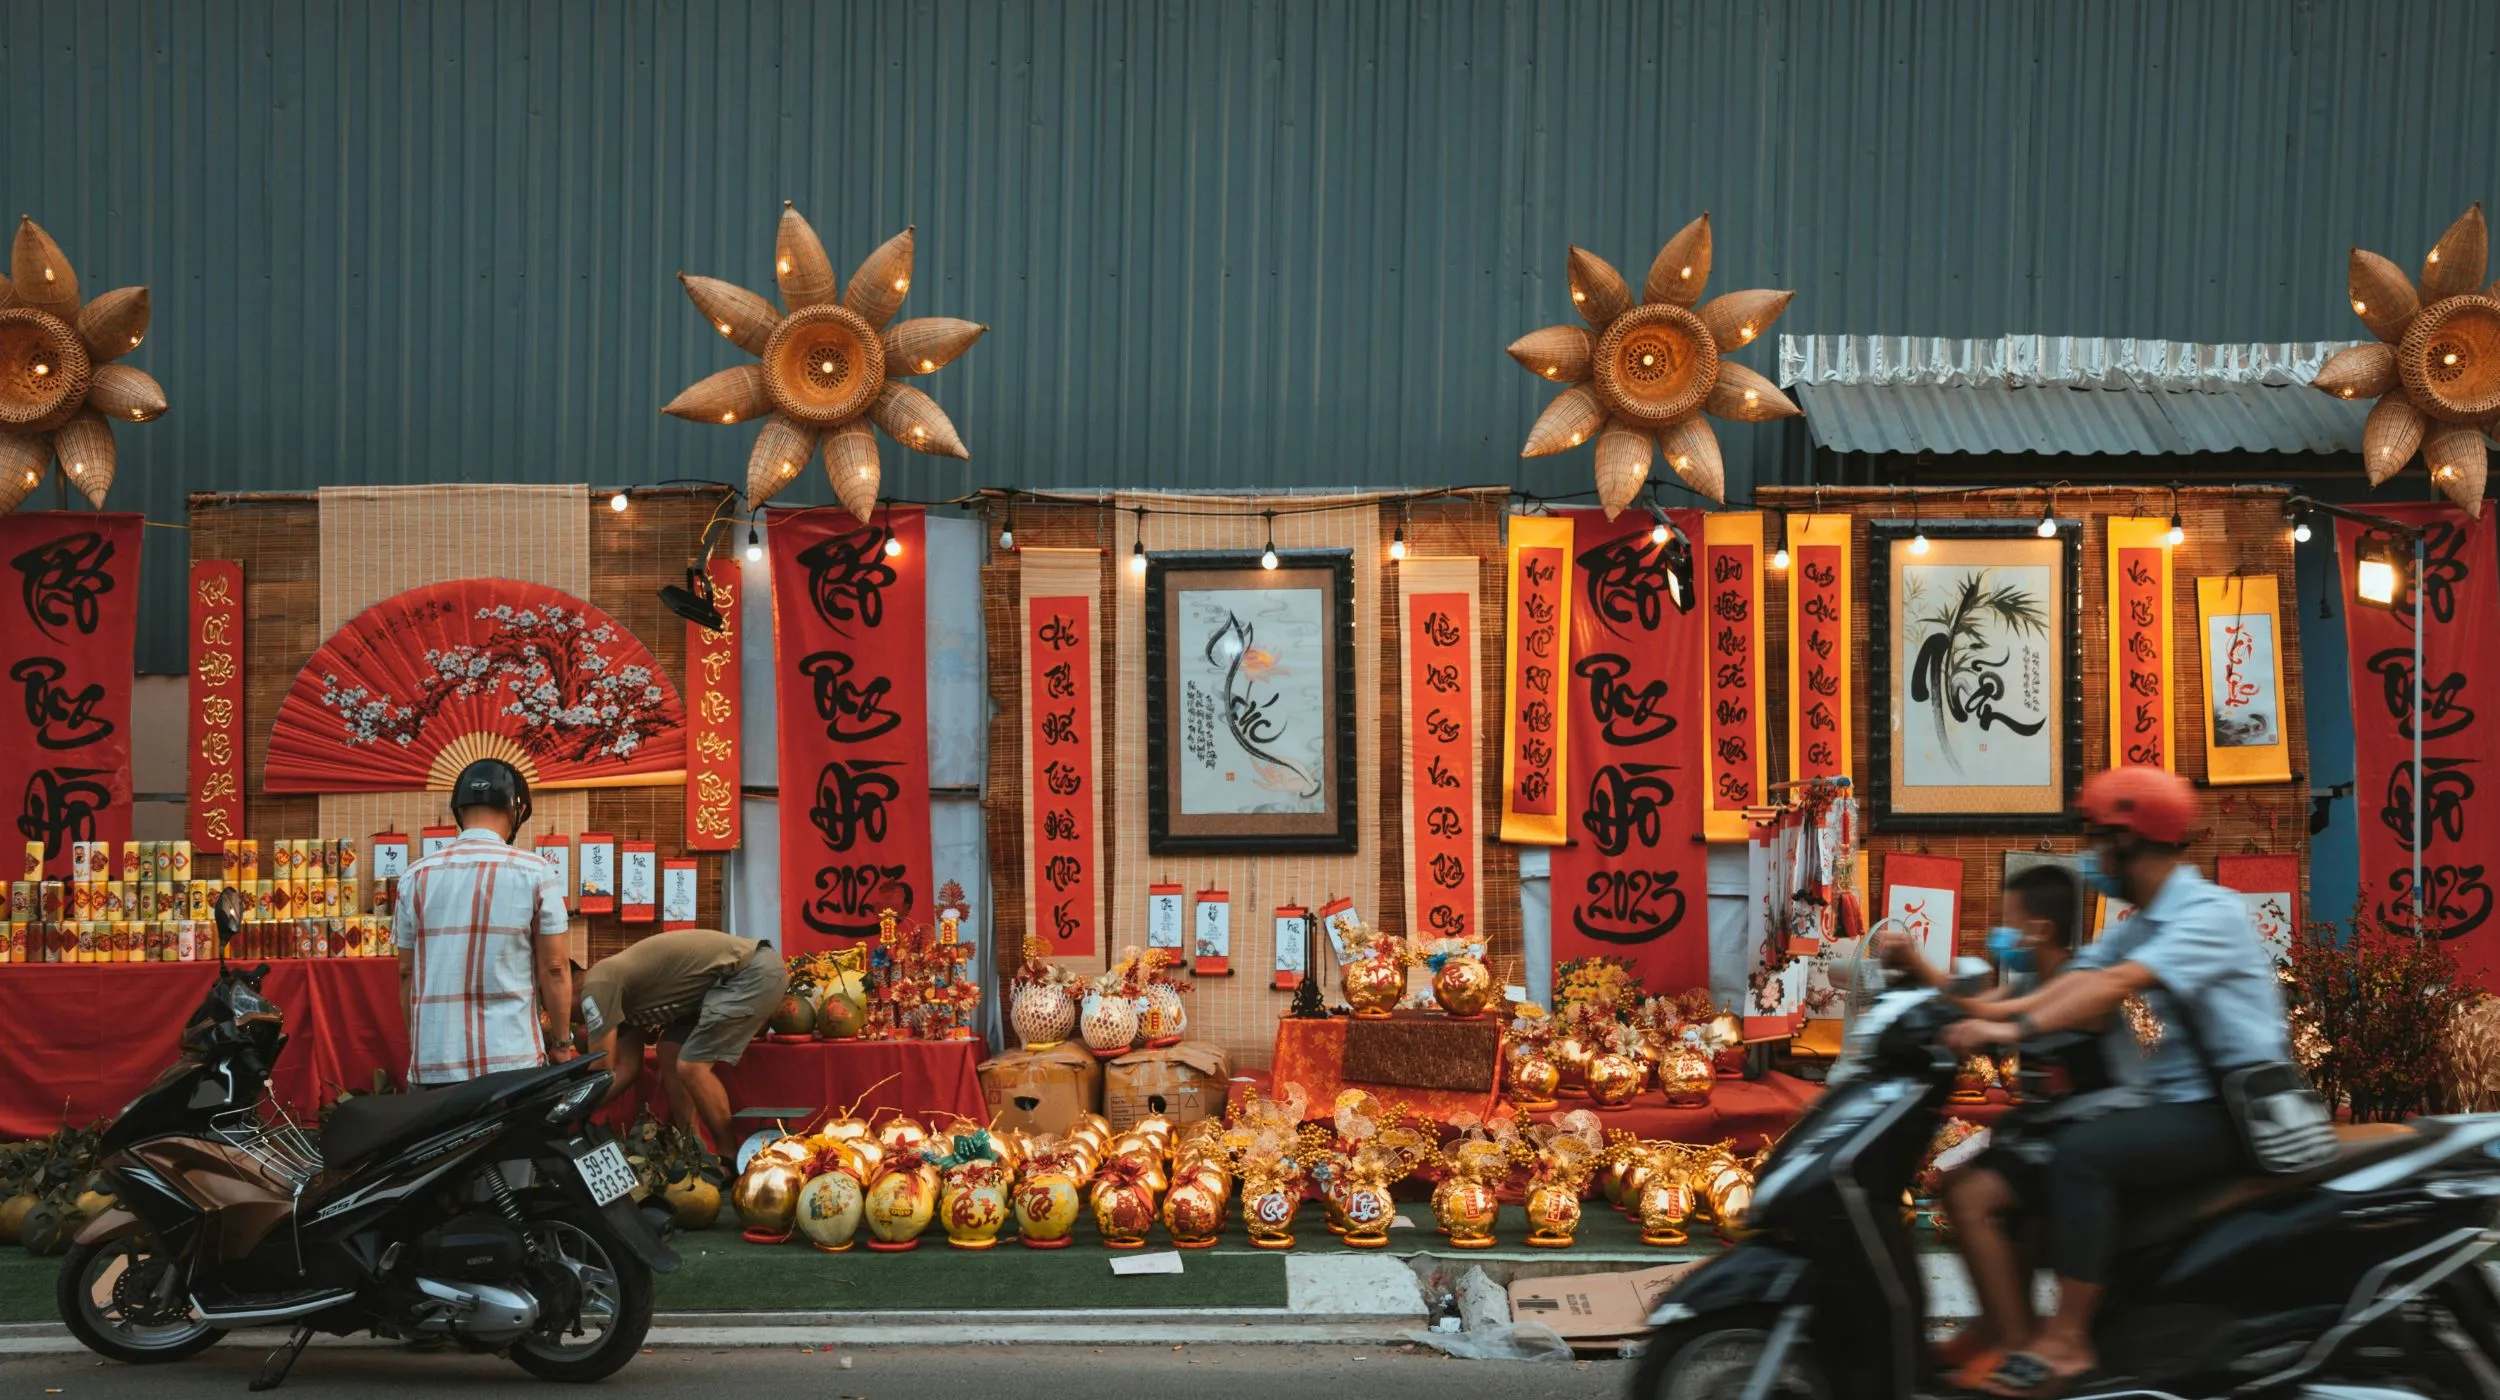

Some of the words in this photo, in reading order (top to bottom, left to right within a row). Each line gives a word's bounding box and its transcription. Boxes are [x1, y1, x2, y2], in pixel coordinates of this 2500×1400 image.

[796, 526, 898, 640] Phố
[1714, 554, 1743, 584] Đào
[1717, 626, 1746, 655] Khoe
[798, 650, 902, 744] Ông
[1574, 652, 1678, 747] Ông
[1717, 656, 1747, 689] Sắc
[9, 656, 115, 751] Ông
[1425, 708, 1461, 744] Sang
[1716, 697, 1748, 726] Đón
[2127, 735, 2161, 767] Cát
[809, 758, 908, 854] Đồ
[1579, 762, 1683, 857] Đồ
[1719, 772, 1749, 802] Sang
[802, 864, 914, 939] 2023
[1573, 869, 1687, 945] 2023
[2375, 864, 2494, 942] 2023
[322, 1199, 351, 1218] 125
[591, 1166, 636, 1202] 533.53
